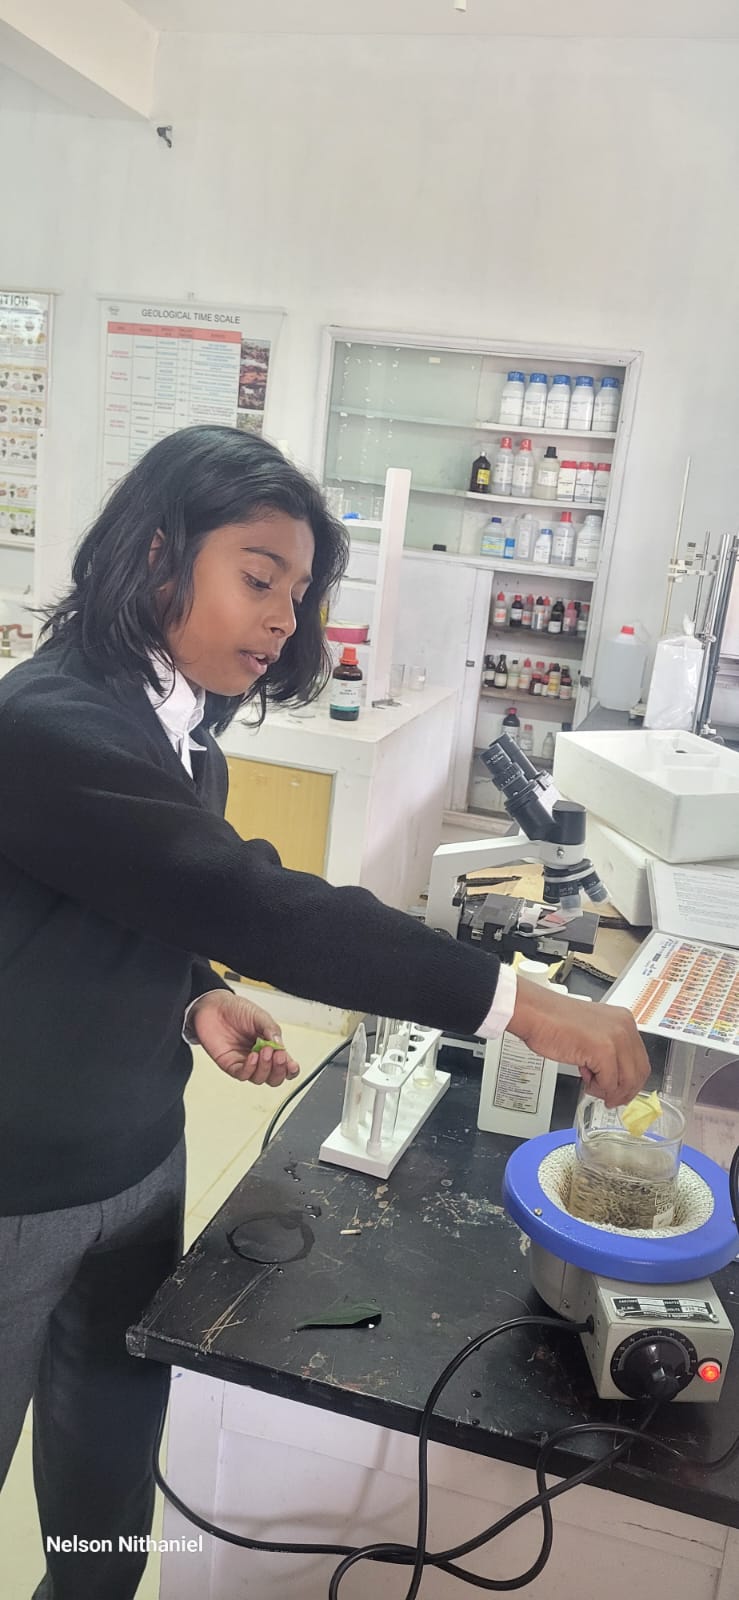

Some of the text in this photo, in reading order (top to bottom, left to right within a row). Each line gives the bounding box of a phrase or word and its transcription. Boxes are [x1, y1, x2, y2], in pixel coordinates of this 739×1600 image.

[141, 308, 241, 325] GEOLOGICAL TIME SCALE
